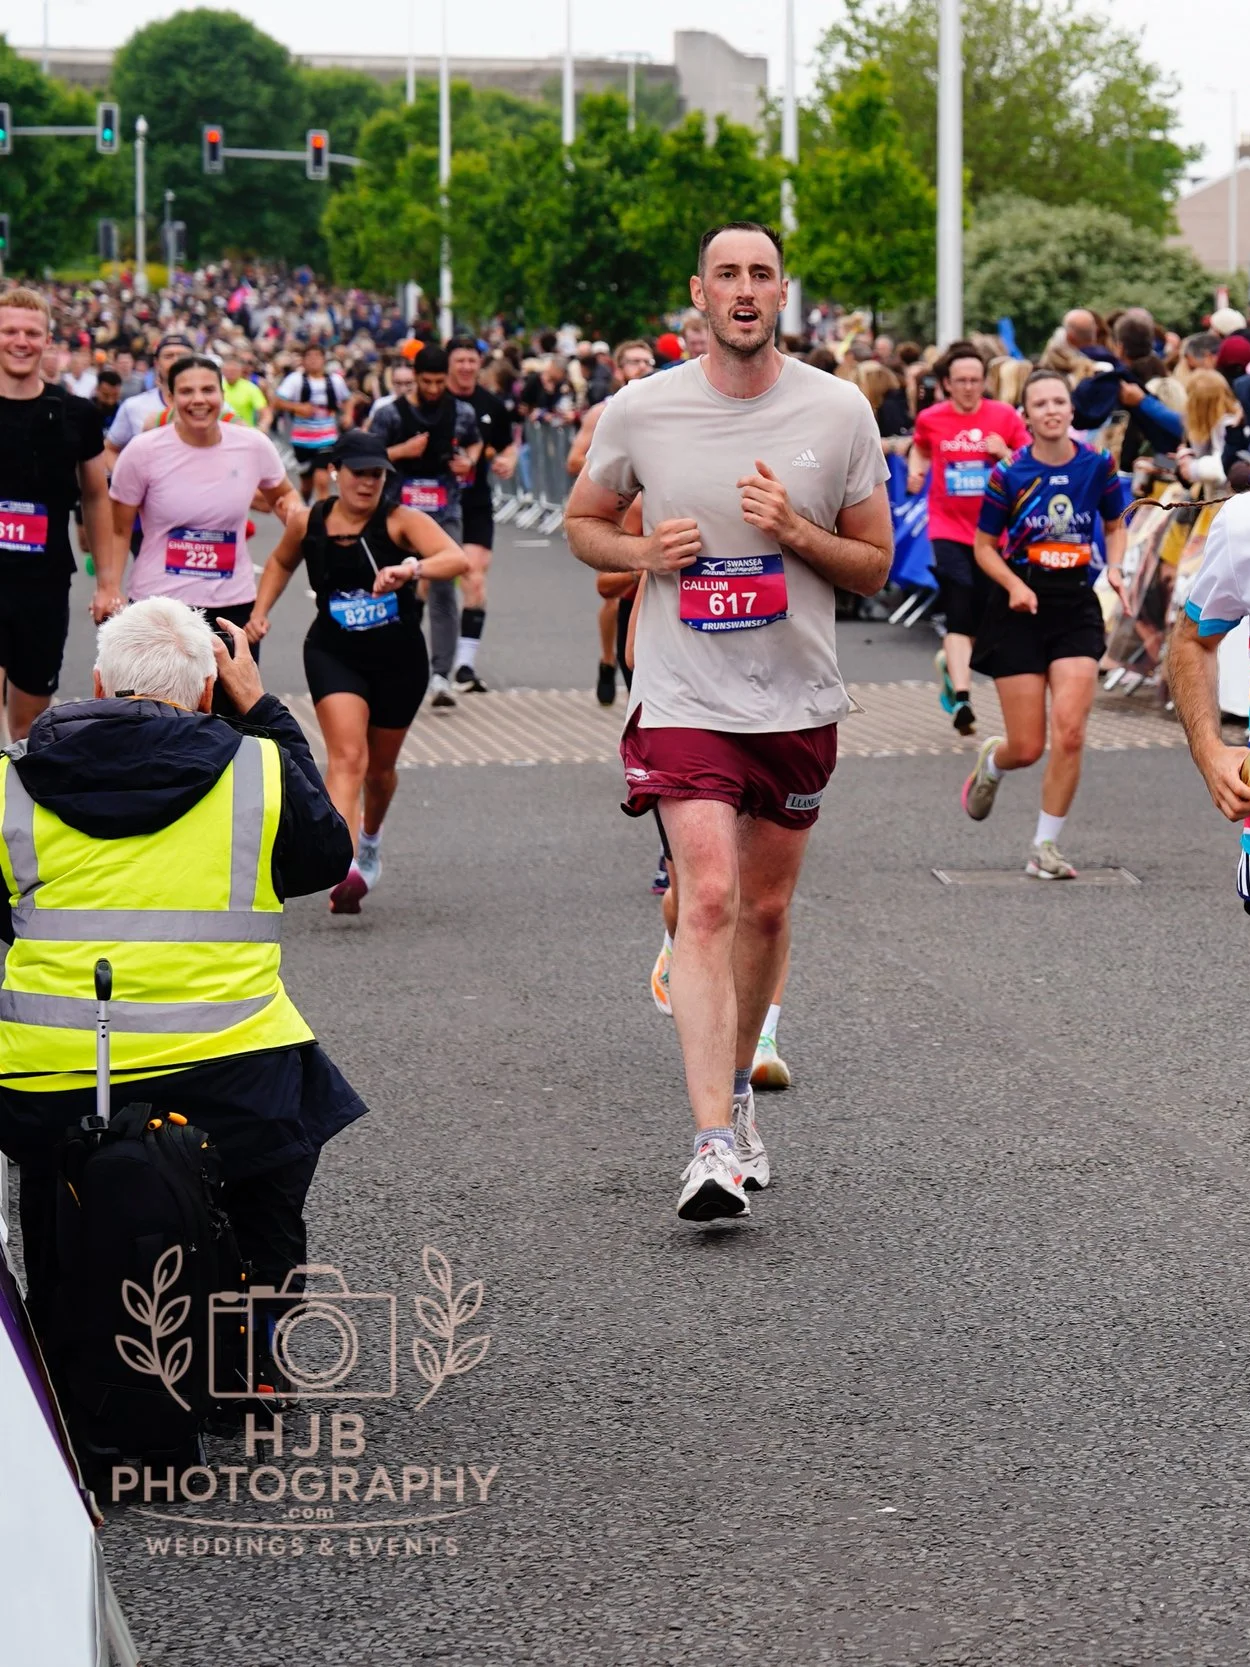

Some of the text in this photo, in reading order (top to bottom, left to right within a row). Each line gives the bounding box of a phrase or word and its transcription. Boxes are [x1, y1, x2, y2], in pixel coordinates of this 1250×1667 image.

[792, 460, 820, 468] adidas
[168, 541, 215, 553] CHARLOTTE
[185, 551, 218, 569] 222
[727, 558, 763, 567] SWANSEA
[682, 580, 728, 591] CALLUM
[709, 592, 757, 616] 617
[702, 619, 767, 631] #RUNSWANSEA
